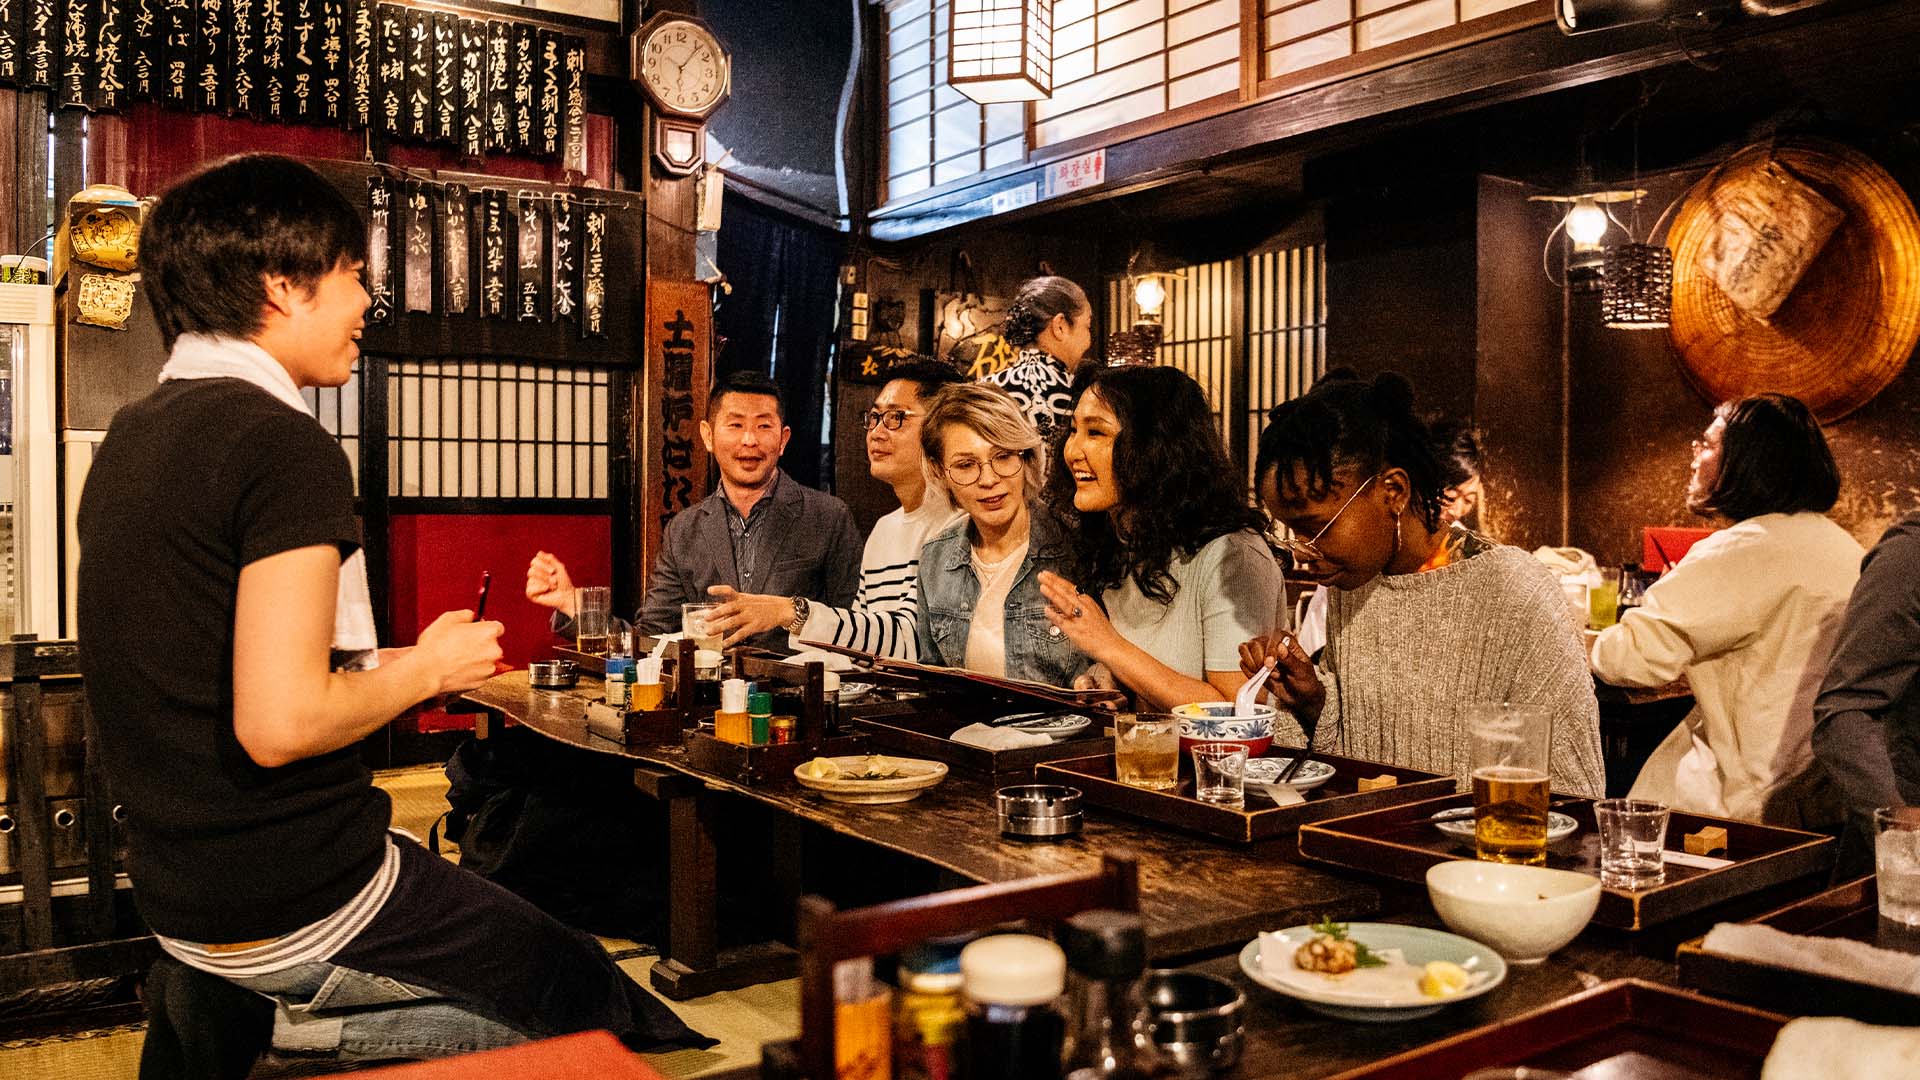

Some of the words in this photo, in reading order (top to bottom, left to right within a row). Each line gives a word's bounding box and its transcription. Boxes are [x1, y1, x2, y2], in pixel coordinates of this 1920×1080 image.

[663, 34, 671, 44] 11
[676, 32, 687, 43] 12
[410, 22, 429, 76] ルイベ
[651, 43, 662, 54] 10
[702, 52, 710, 62] 2
[648, 57, 656, 68] 9
[705, 68, 713, 78] 3
[652, 74, 660, 85] 8
[662, 87, 671, 97] 7
[701, 84, 709, 93] 4
[677, 94, 685, 104] 6
[690, 91, 699, 102] 5
